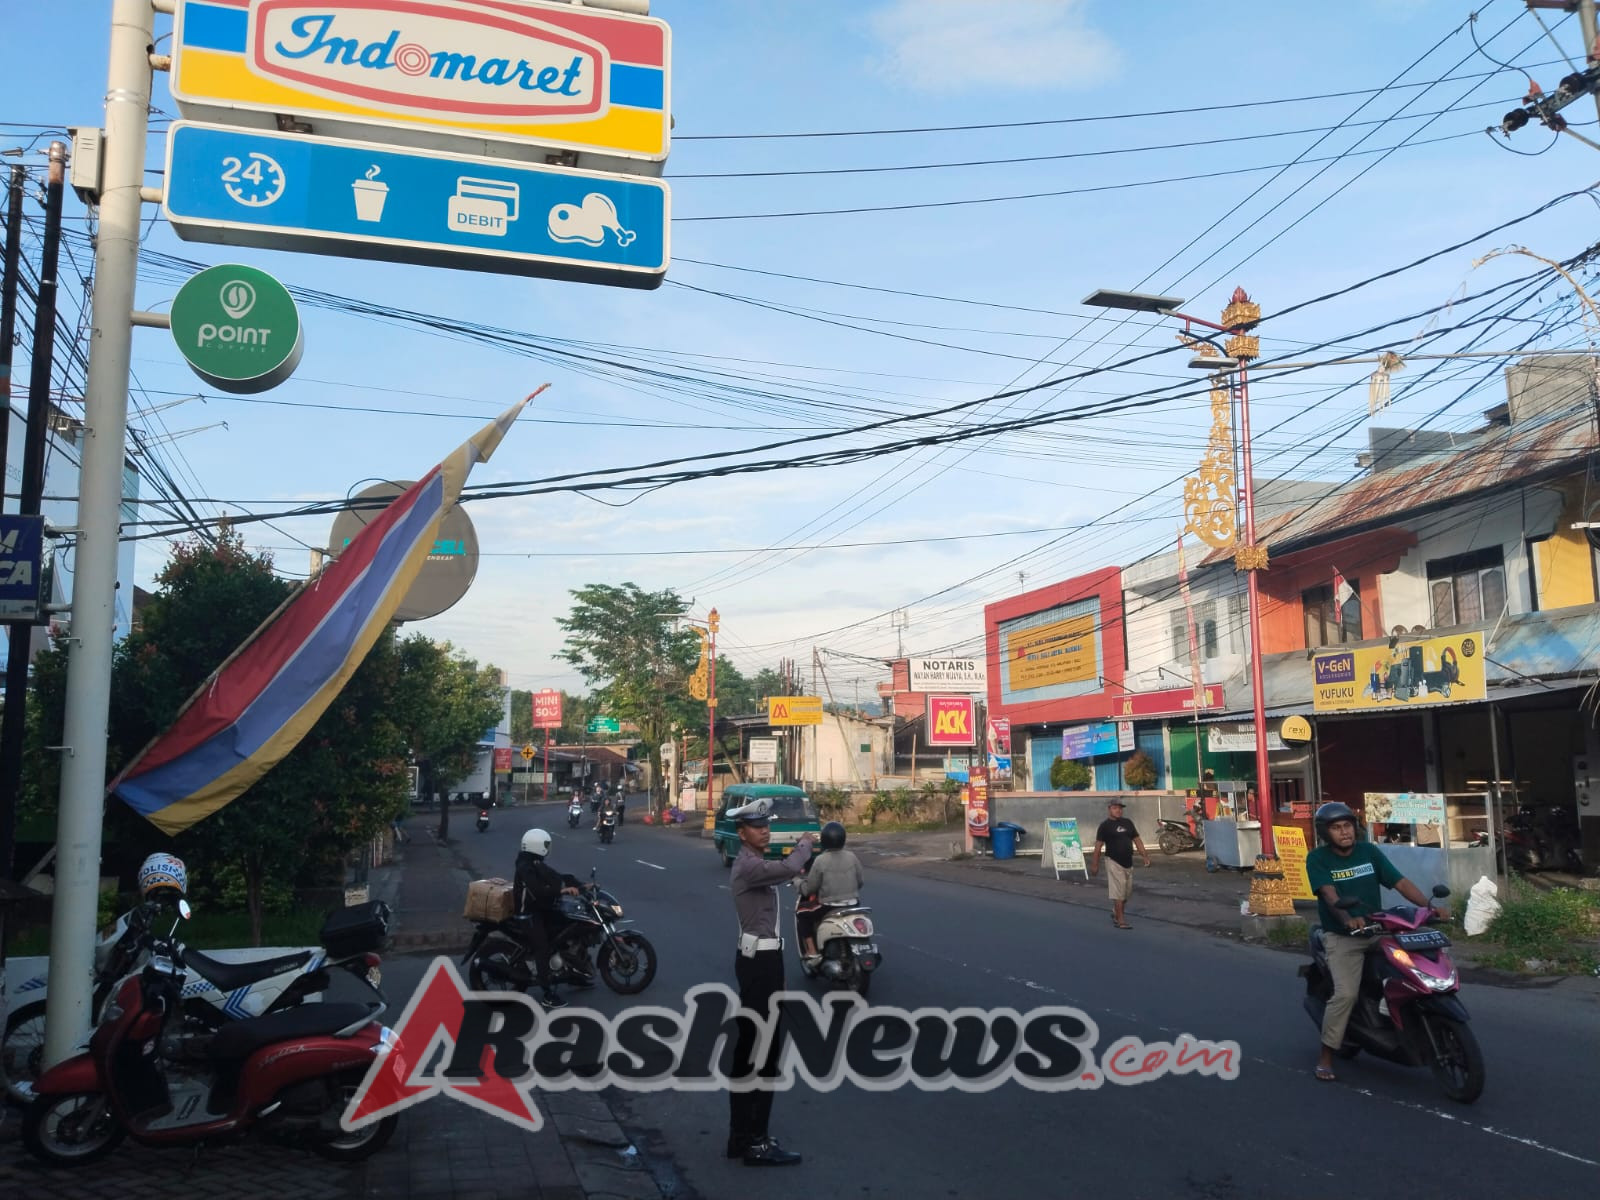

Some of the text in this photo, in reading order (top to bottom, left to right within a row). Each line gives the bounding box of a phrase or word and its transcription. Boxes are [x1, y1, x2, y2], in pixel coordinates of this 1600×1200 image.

[275, 14, 582, 97] Indomaret
[221, 156, 264, 187] 24
[456, 212, 504, 230] DEBIT
[923, 660, 975, 671] NOTARIS
[535, 695, 558, 706] MINI
[1320, 687, 1354, 700] YUFUKU
[934, 710, 968, 734] ACK
